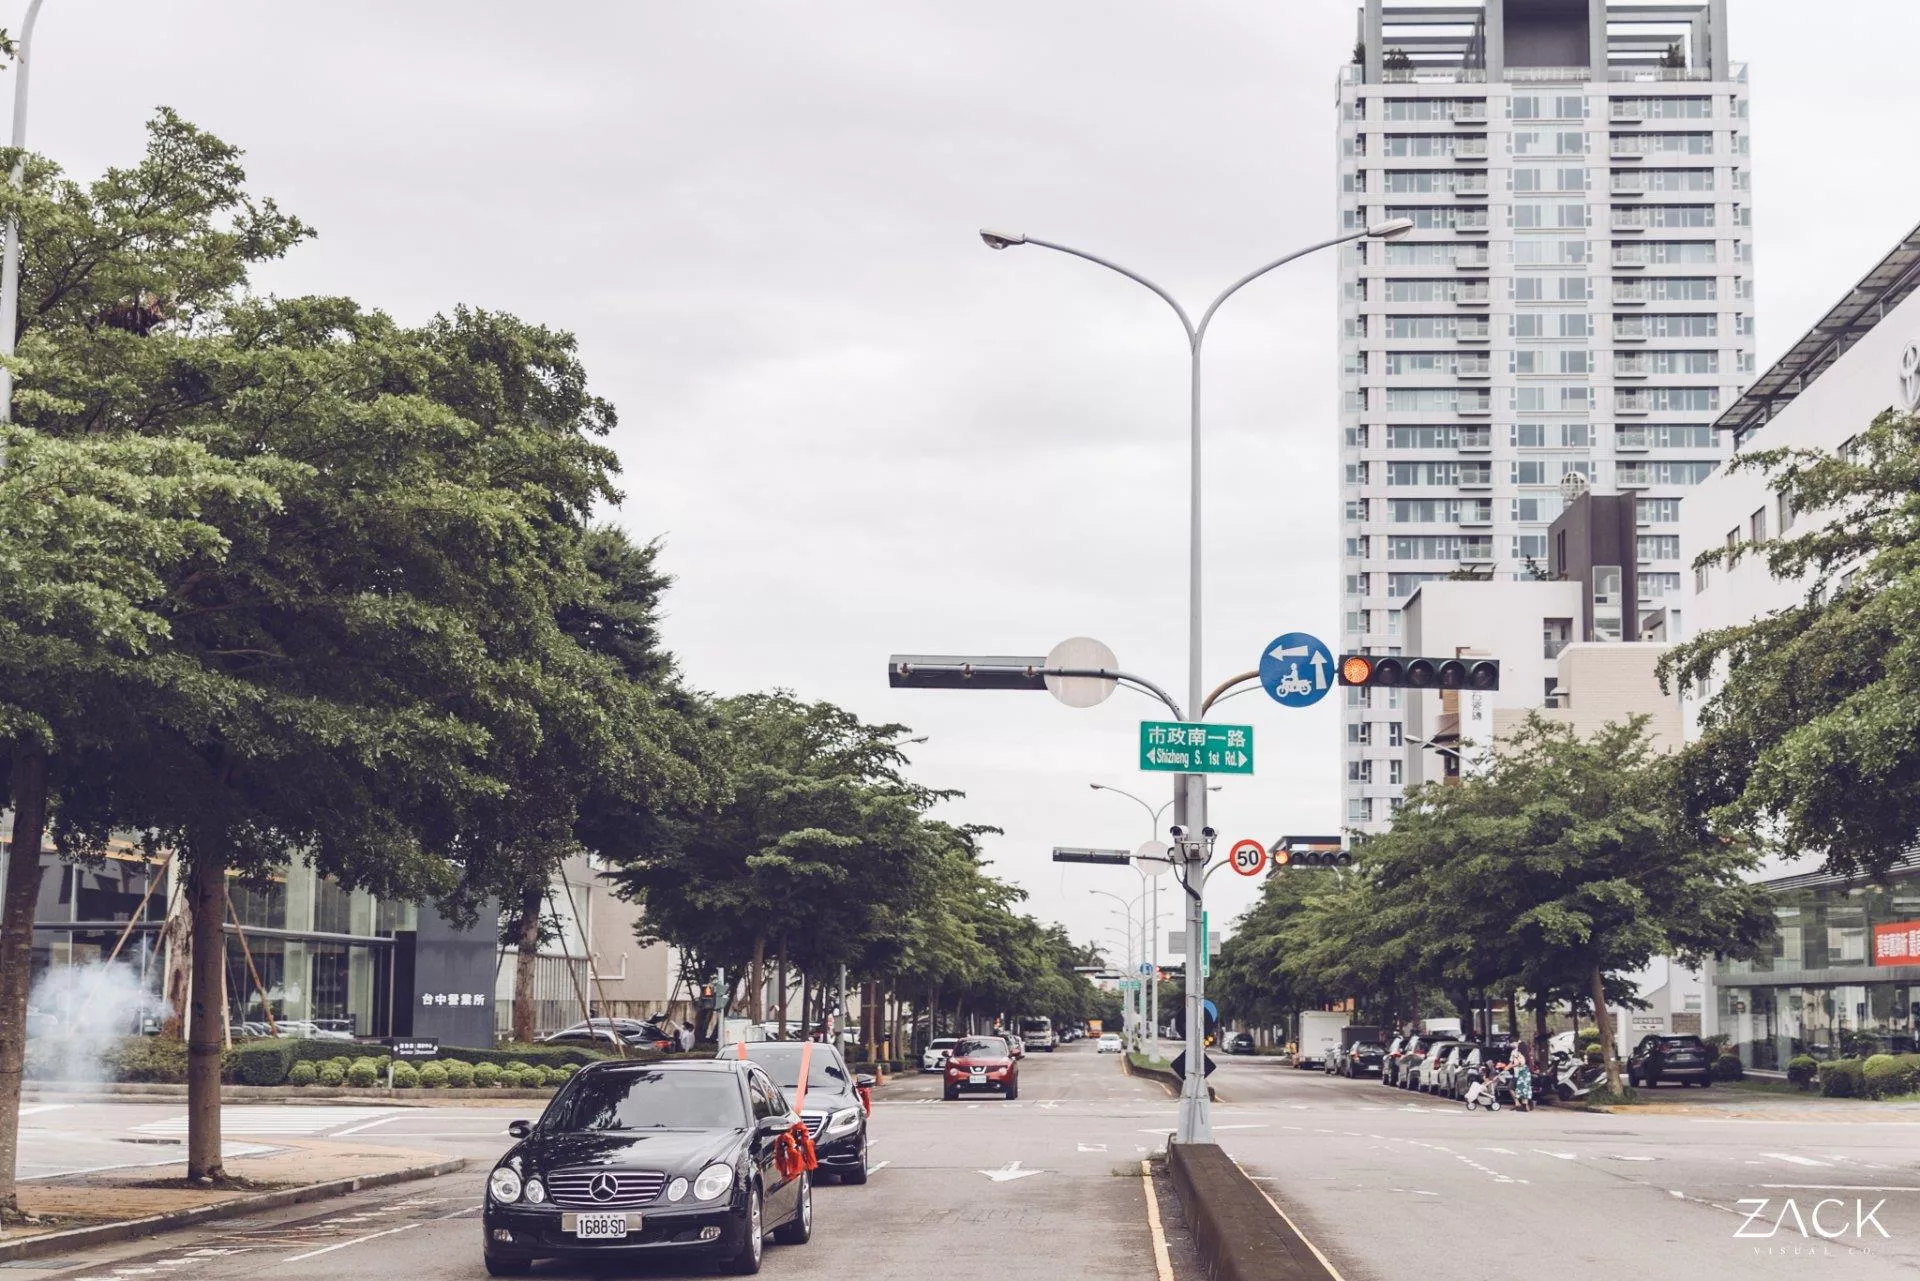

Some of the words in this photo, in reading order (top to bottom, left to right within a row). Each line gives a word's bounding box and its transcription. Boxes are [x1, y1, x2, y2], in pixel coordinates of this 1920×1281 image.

[1148, 726, 1246, 747] 市政南一路
[1157, 748, 1189, 768] Shizheng
[1194, 749, 1203, 765] S.
[1208, 750, 1220, 766] 1st
[1224, 751, 1238, 767] Rd.
[1237, 850, 1259, 867] 50
[422, 993, 485, 1005] 台中營業所
